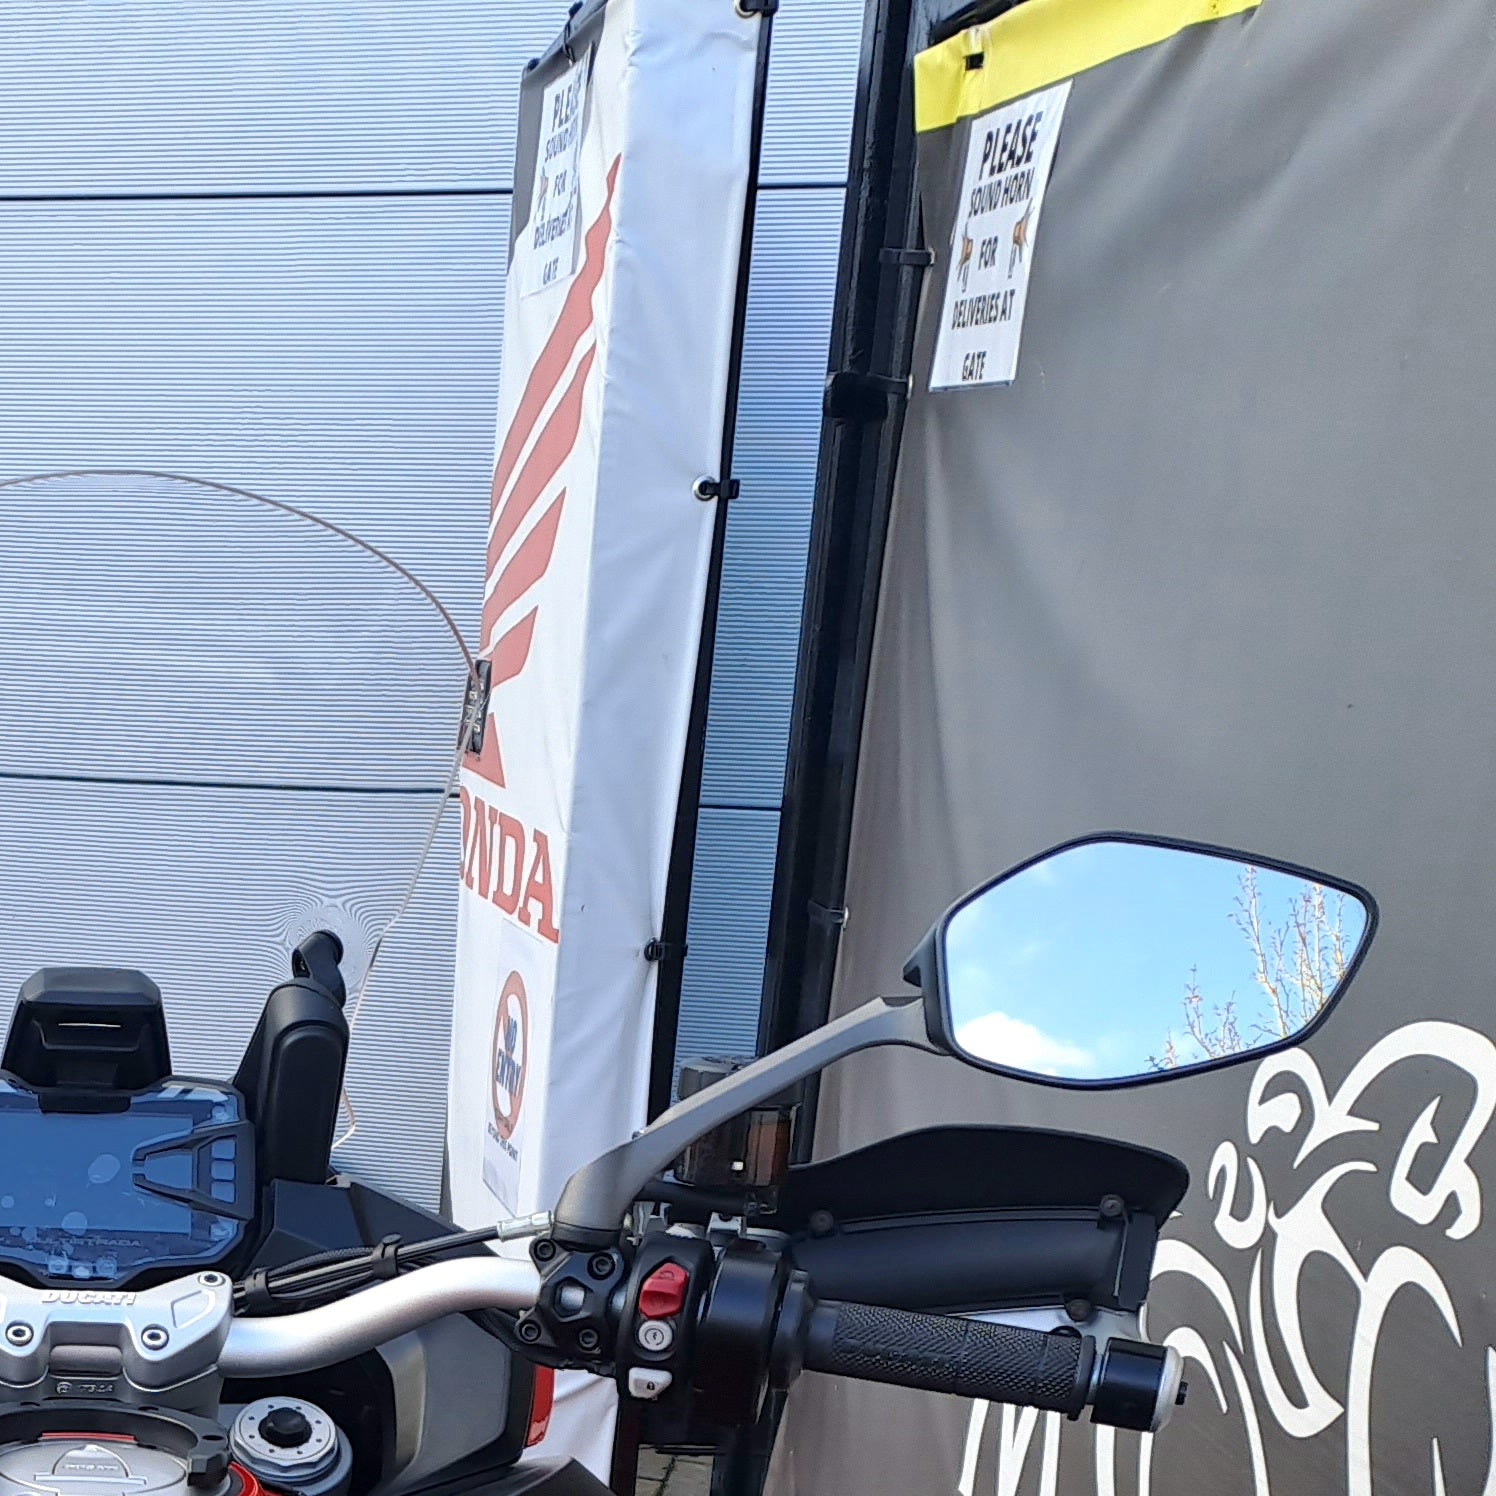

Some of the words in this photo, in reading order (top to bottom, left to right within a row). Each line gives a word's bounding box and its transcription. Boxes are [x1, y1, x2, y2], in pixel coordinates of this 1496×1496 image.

[978, 111, 1044, 181] PLEASE
[554, 169, 567, 198] FOR
[968, 178, 1003, 218] SOUND
[1000, 167, 1035, 208] HORN
[977, 235, 999, 270] FOR
[951, 292, 1001, 329] DELIVERIES
[999, 288, 1016, 321] AT
[961, 350, 987, 381] GATE
[495, 1048, 522, 1098] ENTRY
[41, 1290, 137, 1306] DUCATI
